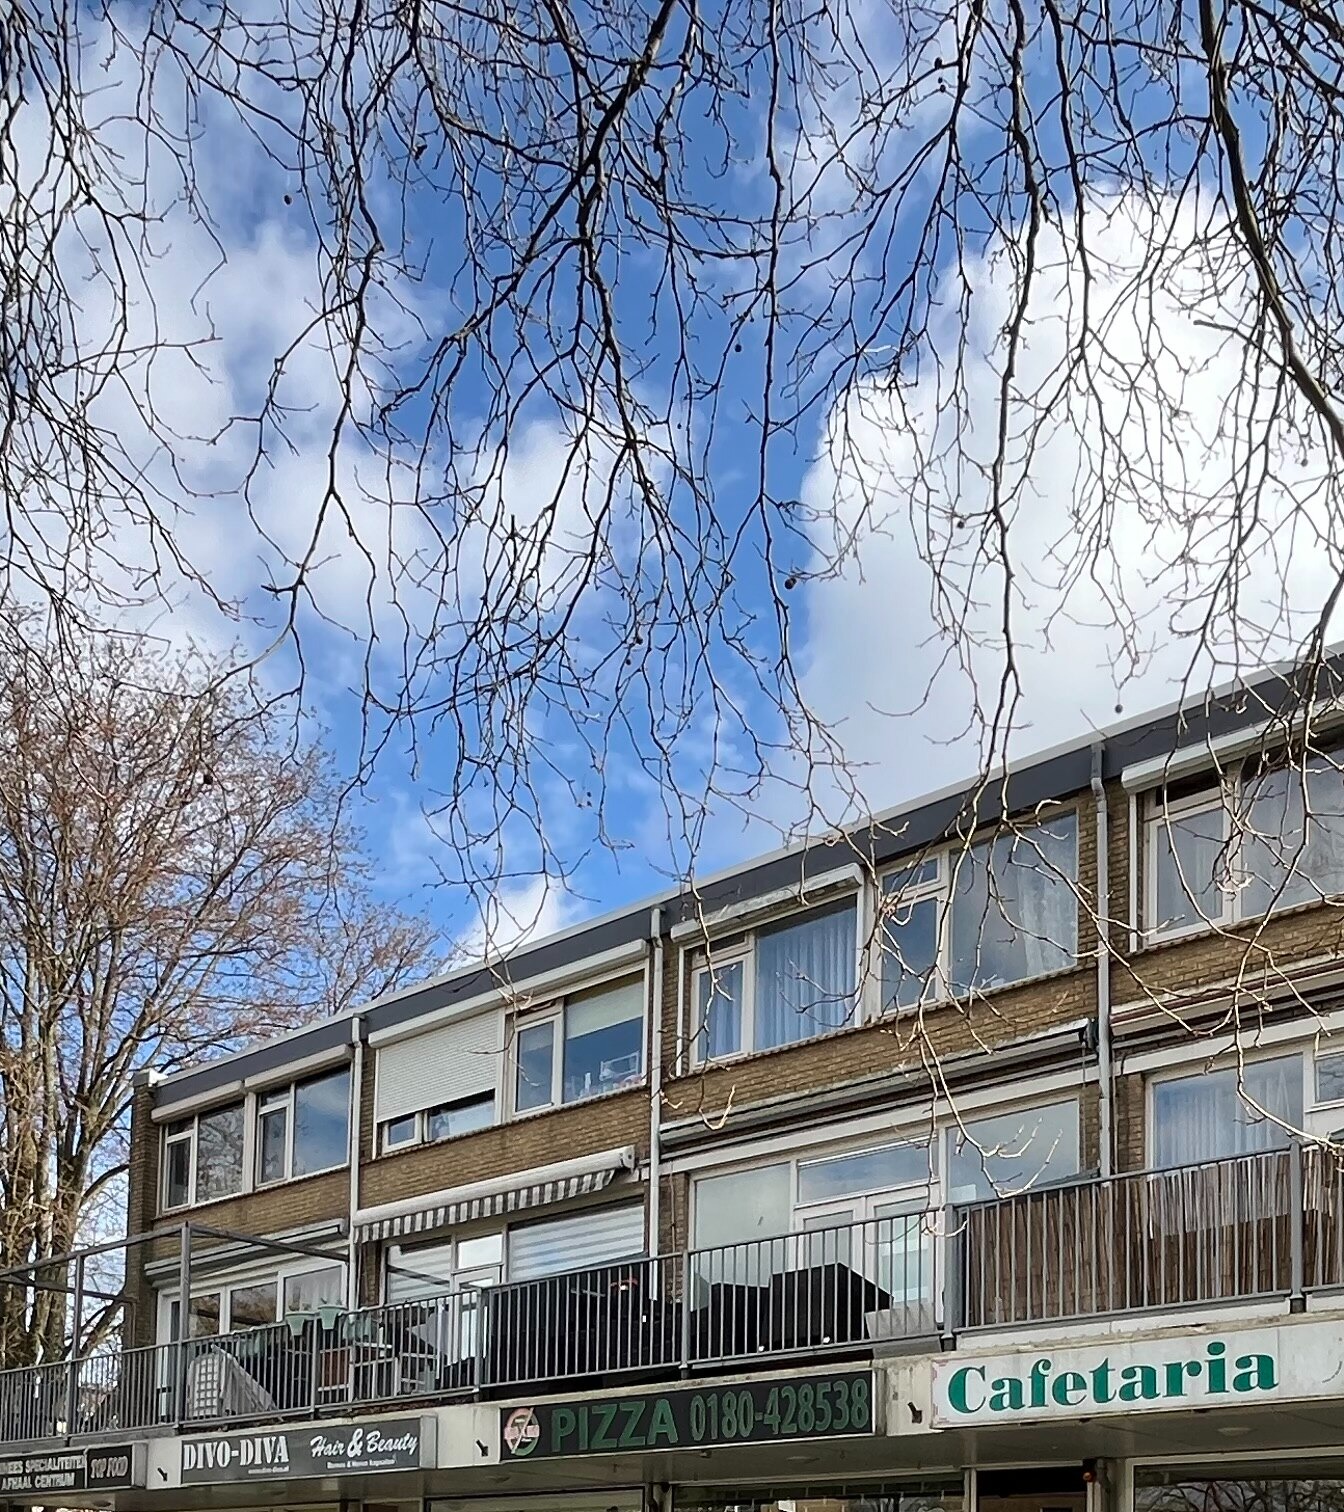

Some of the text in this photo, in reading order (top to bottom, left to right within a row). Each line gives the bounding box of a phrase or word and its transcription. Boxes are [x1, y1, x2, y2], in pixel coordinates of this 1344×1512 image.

[947, 1341, 1279, 1414] Cafetaria
[551, 1378, 869, 1452] PIZZA 0180-428538
[183, 1436, 290, 1470] DIVO-DIVA
[310, 1428, 419, 1458] Hair & Beauty
[34, 1472, 76, 1489] CENTRUM
